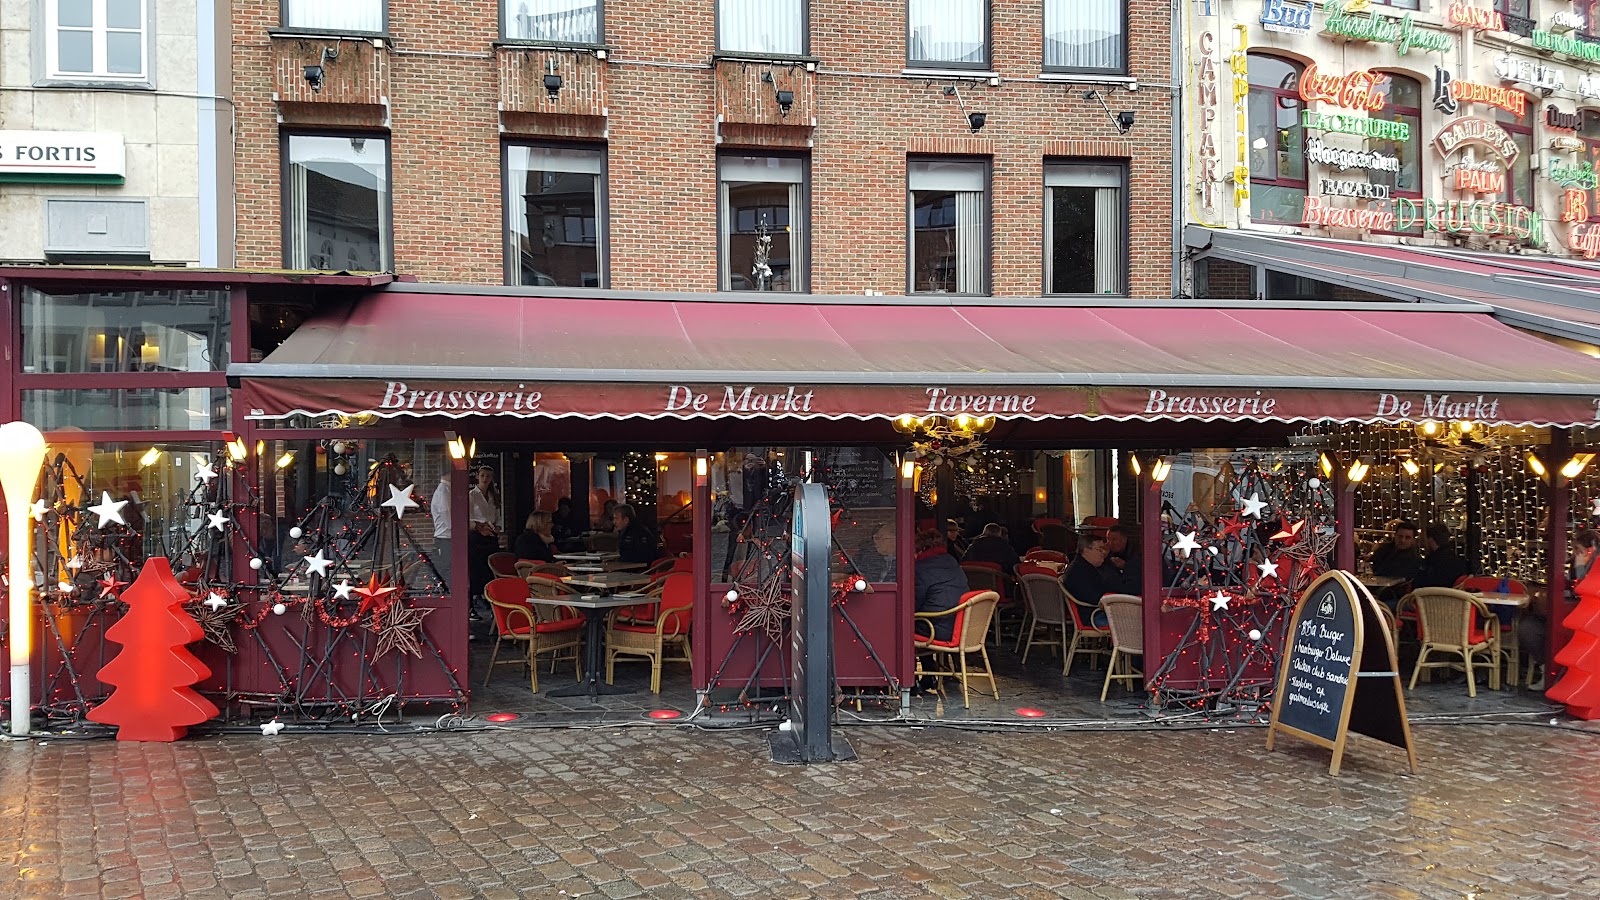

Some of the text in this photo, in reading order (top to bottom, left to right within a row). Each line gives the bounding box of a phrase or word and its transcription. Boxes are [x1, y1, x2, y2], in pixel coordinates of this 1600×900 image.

[1259, 0, 1314, 29] Bud
[1450, 2, 1505, 31] GANCIA
[1433, 65, 1526, 119] RODENBACH
[1198, 31, 1217, 208] CAMPARI
[1546, 104, 1585, 132] Duvel
[1439, 119, 1519, 158] BAILEYS
[15, 146, 96, 161] FORTIS
[1321, 179, 1391, 200] BACARDI
[1456, 169, 1504, 193] PALM
[1301, 196, 1393, 231] Brasserie
[379, 381, 1499, 419] Brasserie De Markt Taverne Brasserie De Markt
[1319, 623, 1345, 646] Burger
[1325, 646, 1351, 666] Deluxe
[1311, 665, 1325, 678] club
